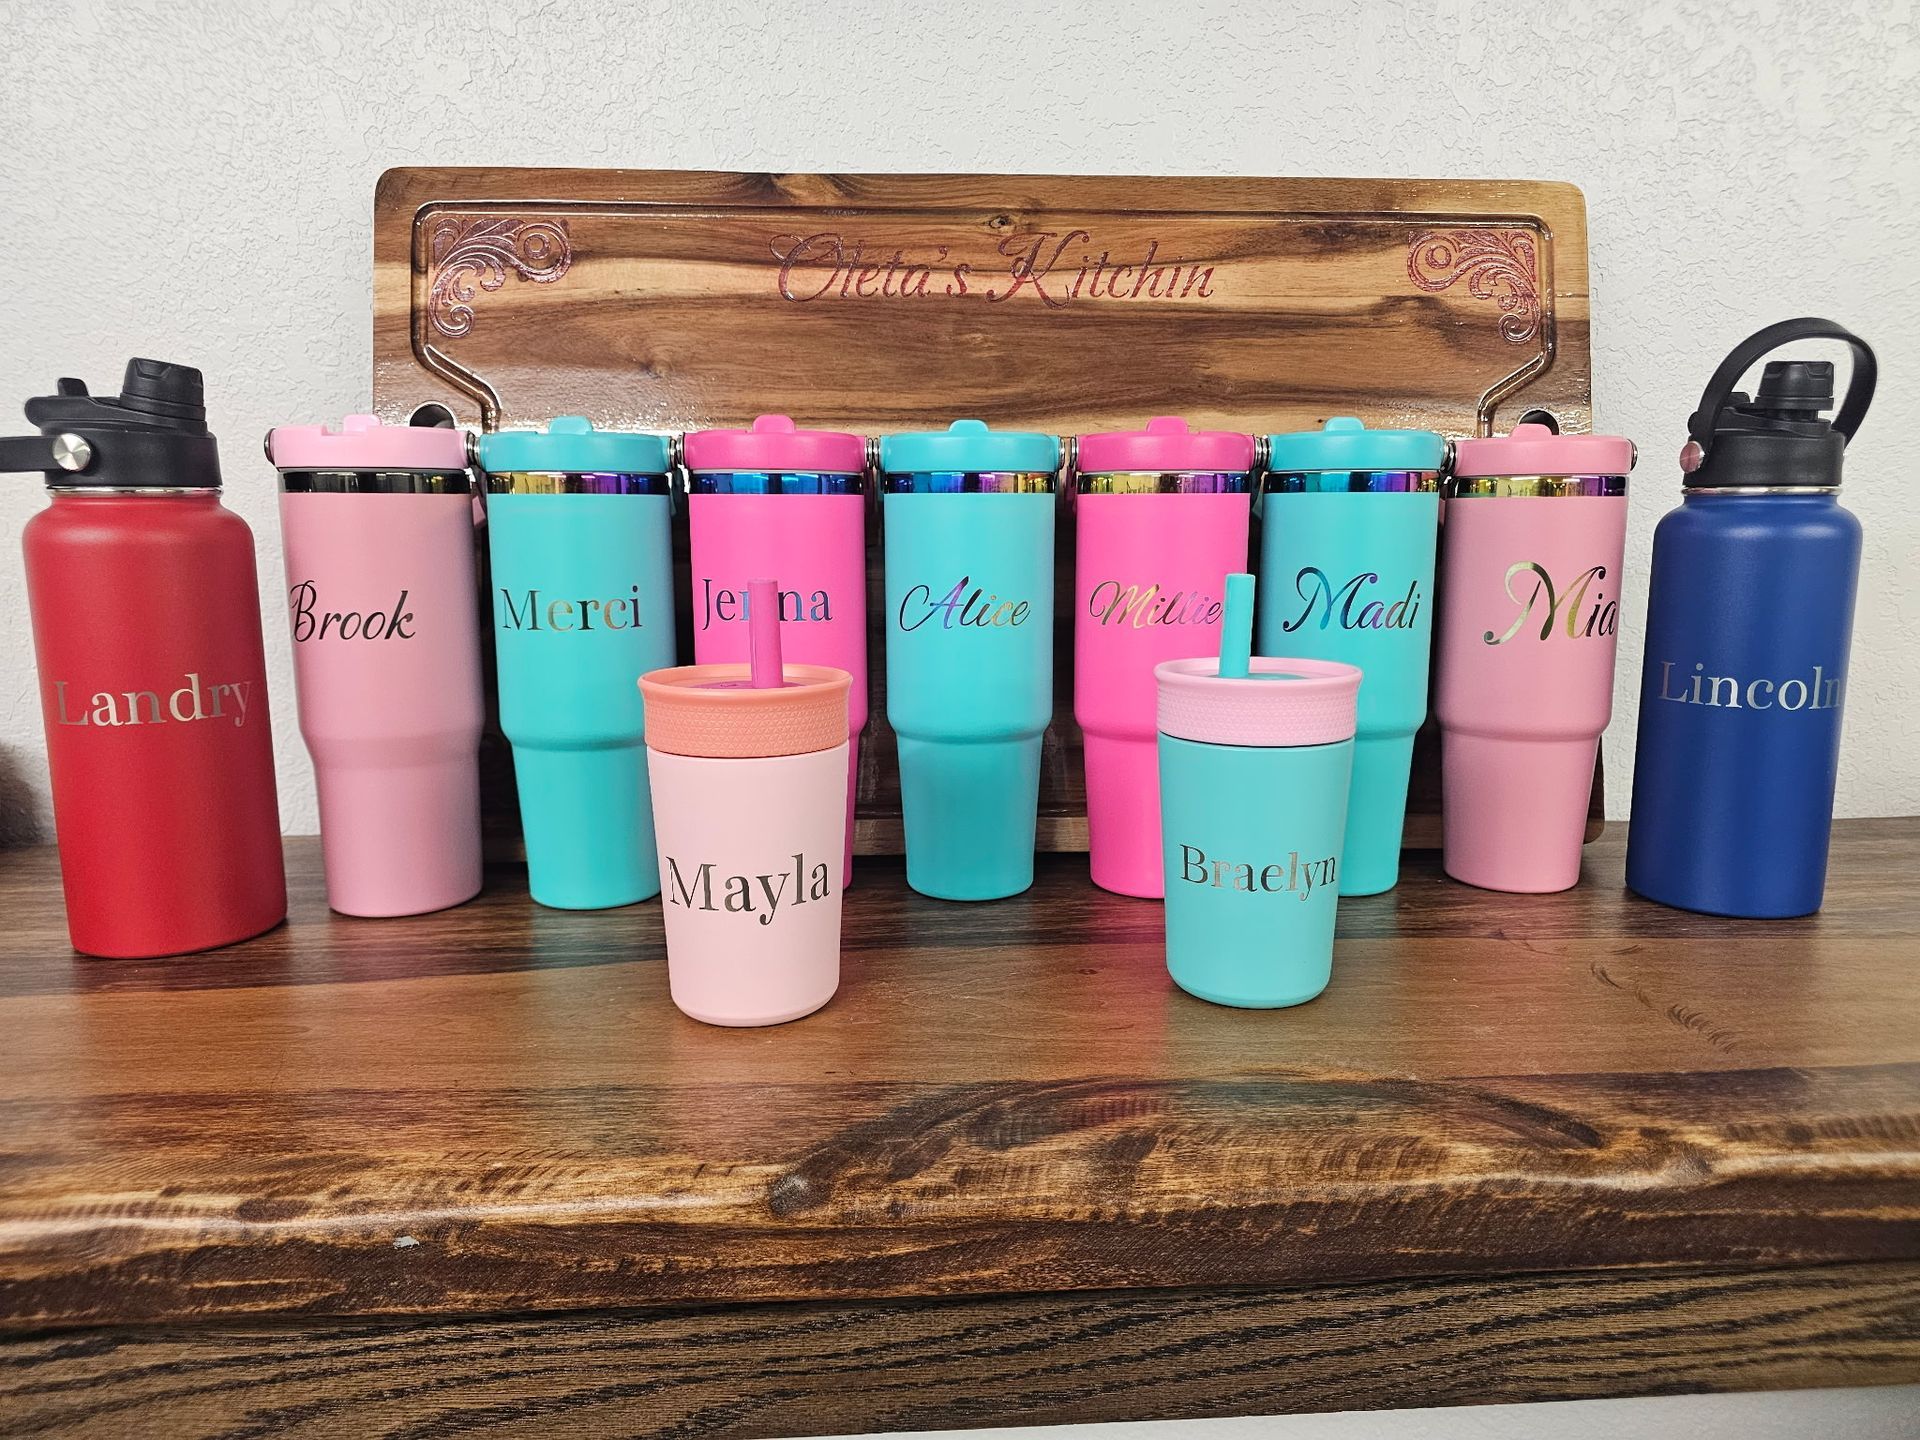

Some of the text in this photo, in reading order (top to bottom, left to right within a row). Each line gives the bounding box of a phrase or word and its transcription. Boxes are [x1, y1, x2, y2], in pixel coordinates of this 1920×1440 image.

[770, 230, 1215, 310] Oleta's Kitchin
[290, 579, 416, 642] Brook
[500, 585, 643, 632] Merci
[900, 575, 1030, 632] Alice
[1089, 580, 1223, 630] Millie
[1283, 566, 1420, 632] Madi
[1484, 560, 1617, 645] Mia
[54, 673, 253, 727] Landry
[1658, 661, 1841, 710] Lincoln
[665, 853, 831, 926] Mayla
[1179, 844, 1336, 902] Braelyn
